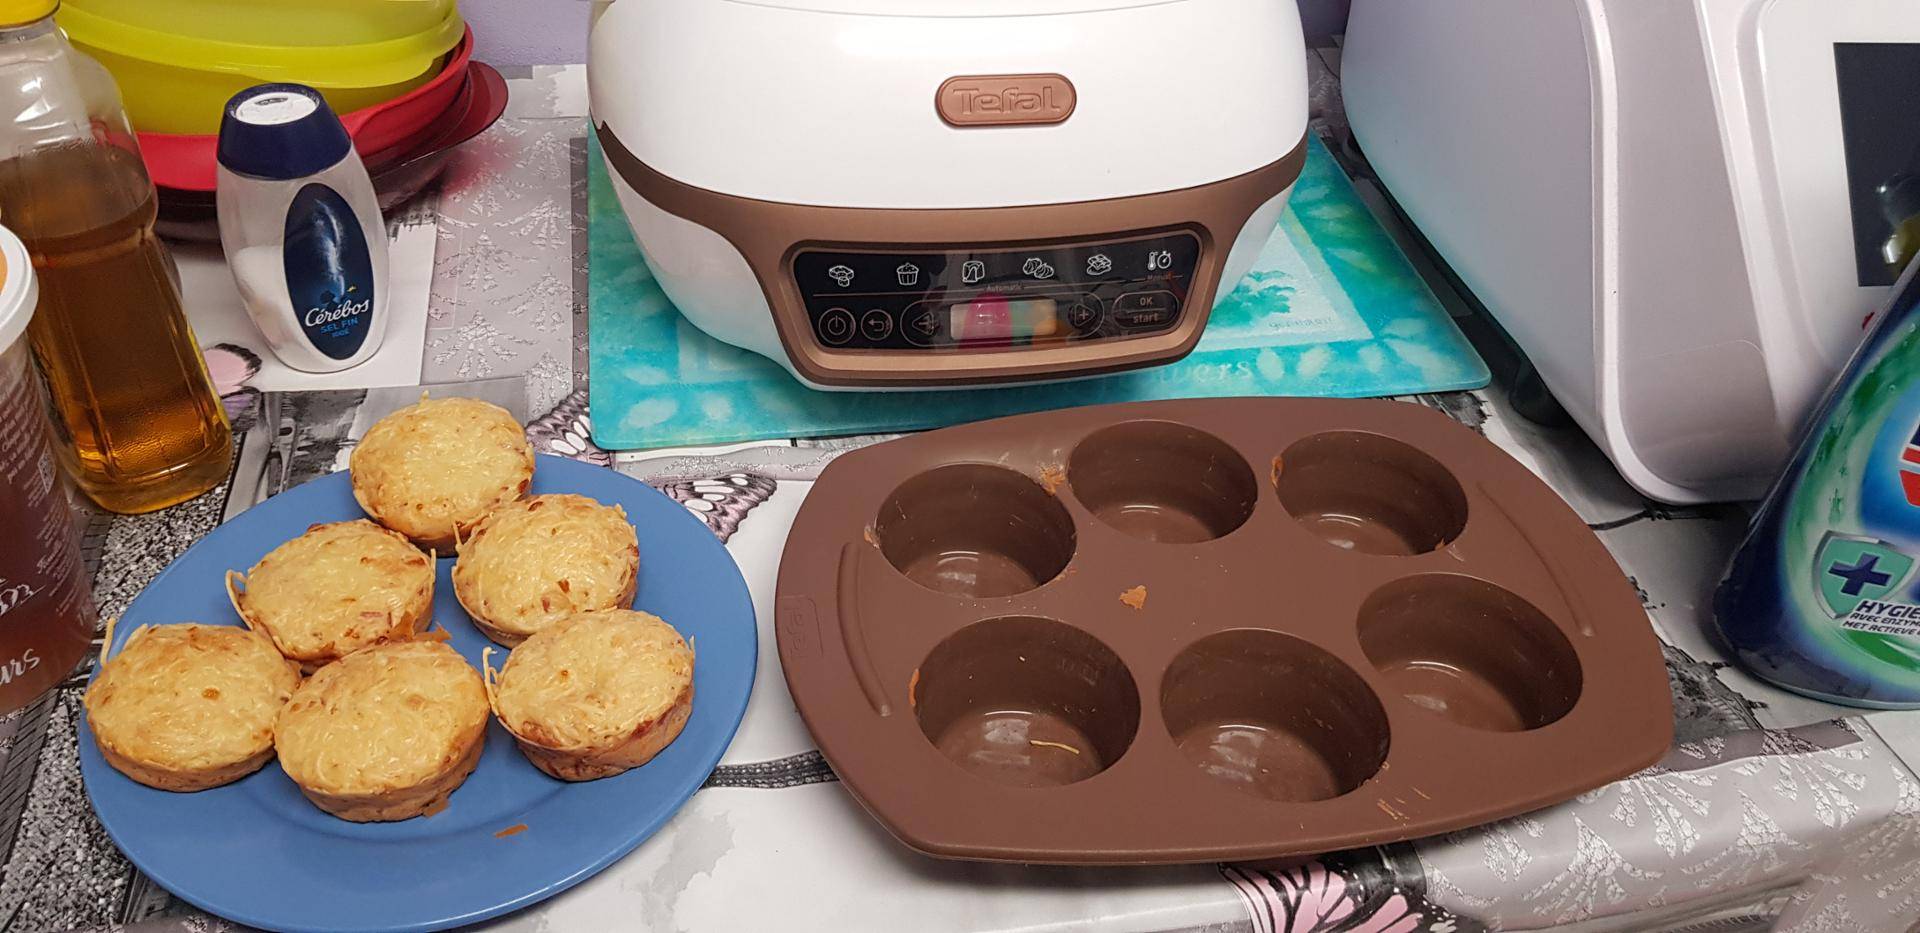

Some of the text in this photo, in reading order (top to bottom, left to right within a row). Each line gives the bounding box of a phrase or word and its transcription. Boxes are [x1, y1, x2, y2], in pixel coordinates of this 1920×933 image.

[952, 86, 1061, 115] Tefal
[1139, 296, 1154, 306] OK
[305, 299, 369, 326] Cérébos
[1133, 312, 1161, 324] start
[320, 317, 359, 334] SEL FIN
[1849, 612, 1881, 623] AVEC
[1842, 621, 1869, 630] MET
